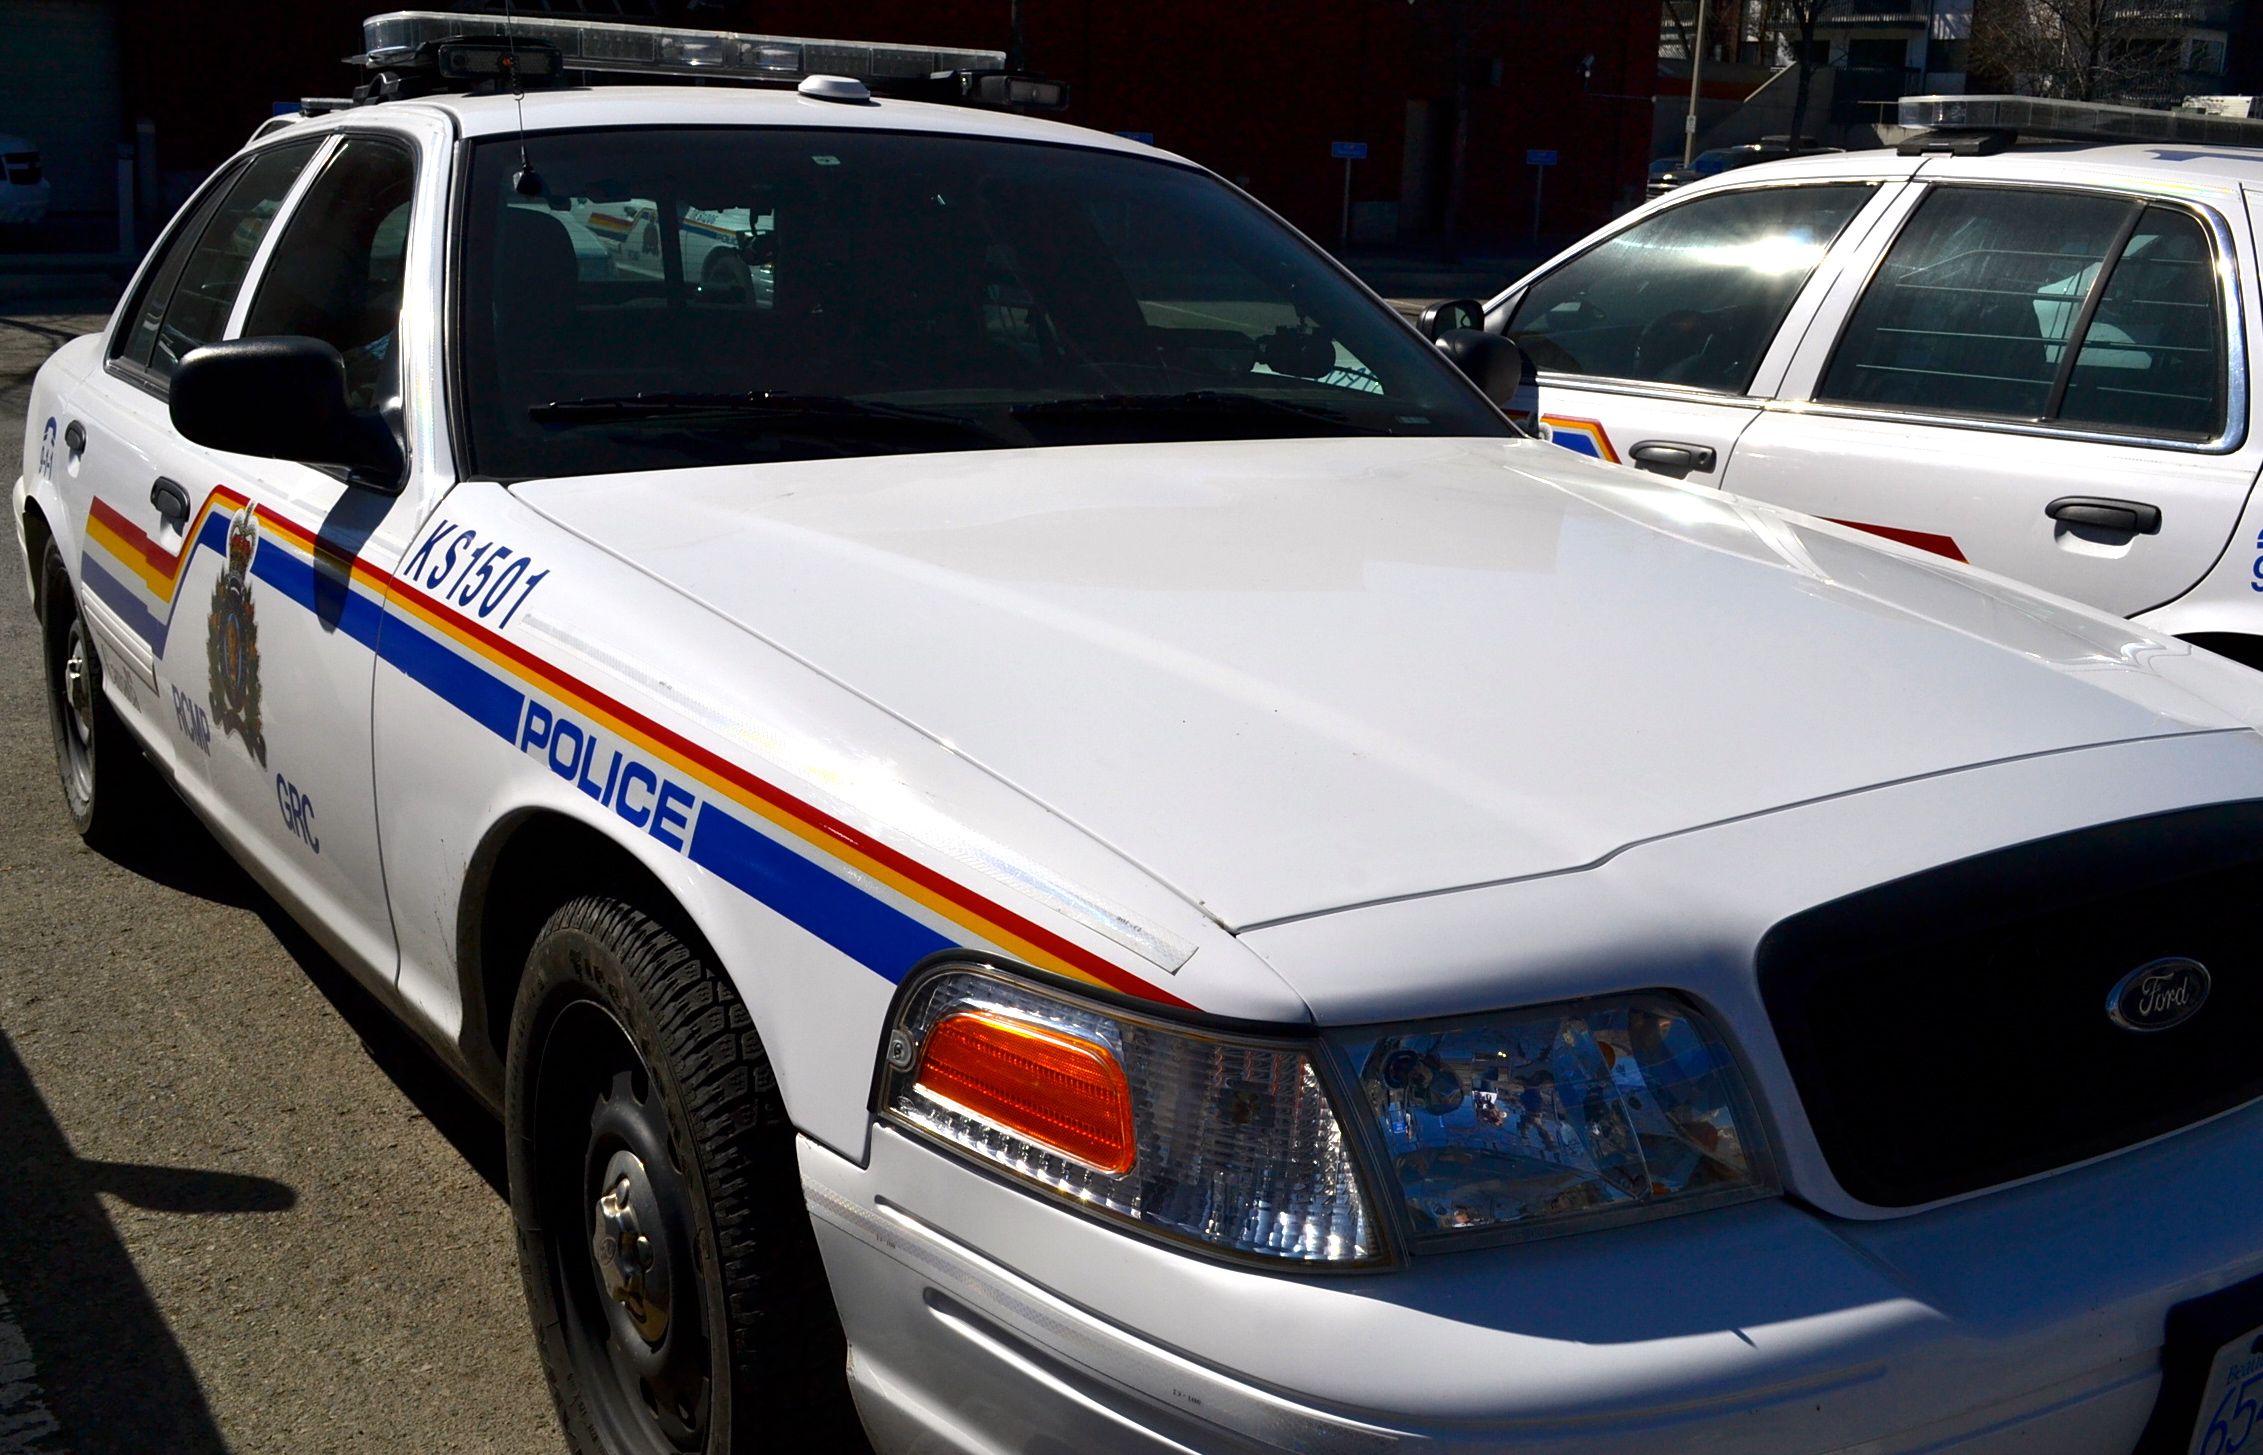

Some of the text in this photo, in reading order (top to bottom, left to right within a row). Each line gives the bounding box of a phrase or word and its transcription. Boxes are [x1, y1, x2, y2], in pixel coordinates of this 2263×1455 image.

[403, 519, 551, 630] KS1501
[171, 683, 211, 757] RCMP
[276, 773, 319, 854] GRC
[520, 699, 696, 853] POLICE
[2139, 972, 2190, 1016] Ford
[2197, 1369, 2263, 1455] 65
